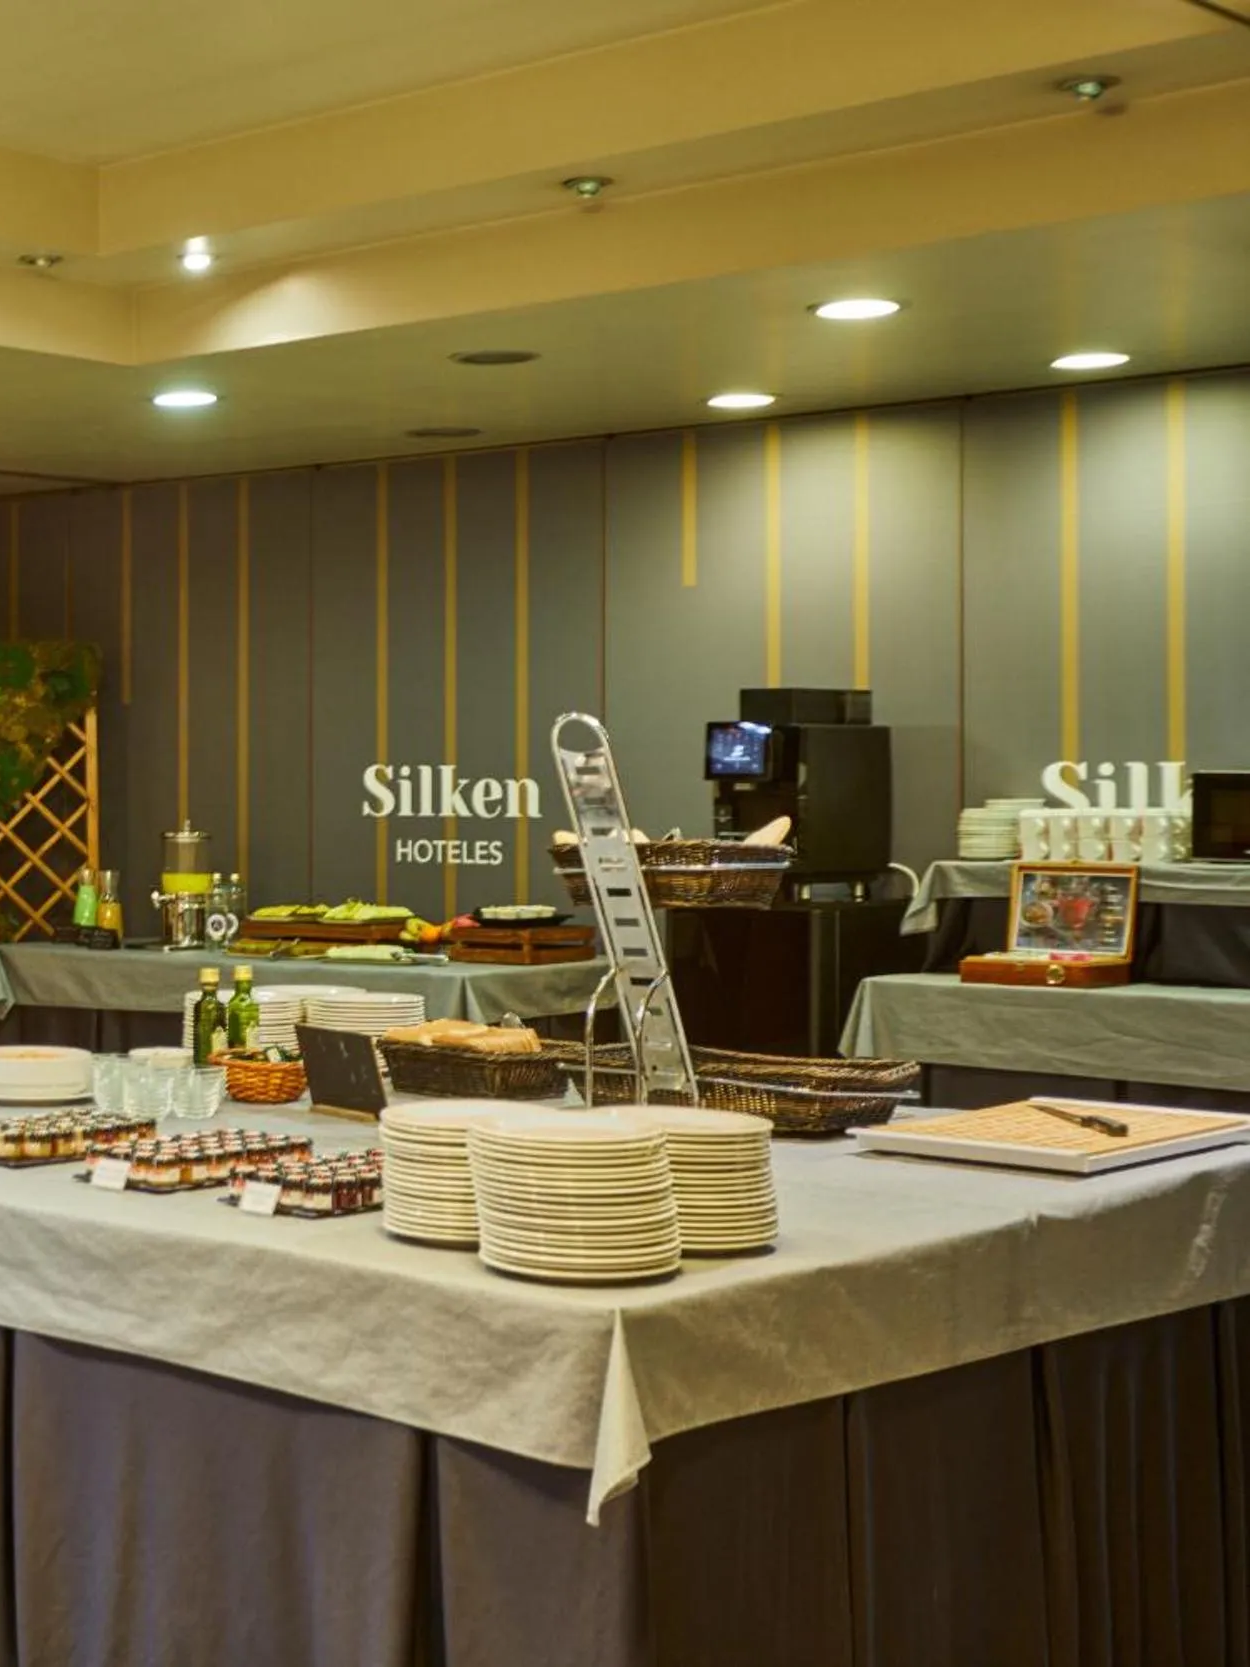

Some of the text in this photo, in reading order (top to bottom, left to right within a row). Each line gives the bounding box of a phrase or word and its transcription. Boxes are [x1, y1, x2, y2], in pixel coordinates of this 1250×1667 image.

[362, 764, 543, 818] Silken
[1041, 761, 1193, 809] Silk
[396, 839, 503, 865] HOTELES
